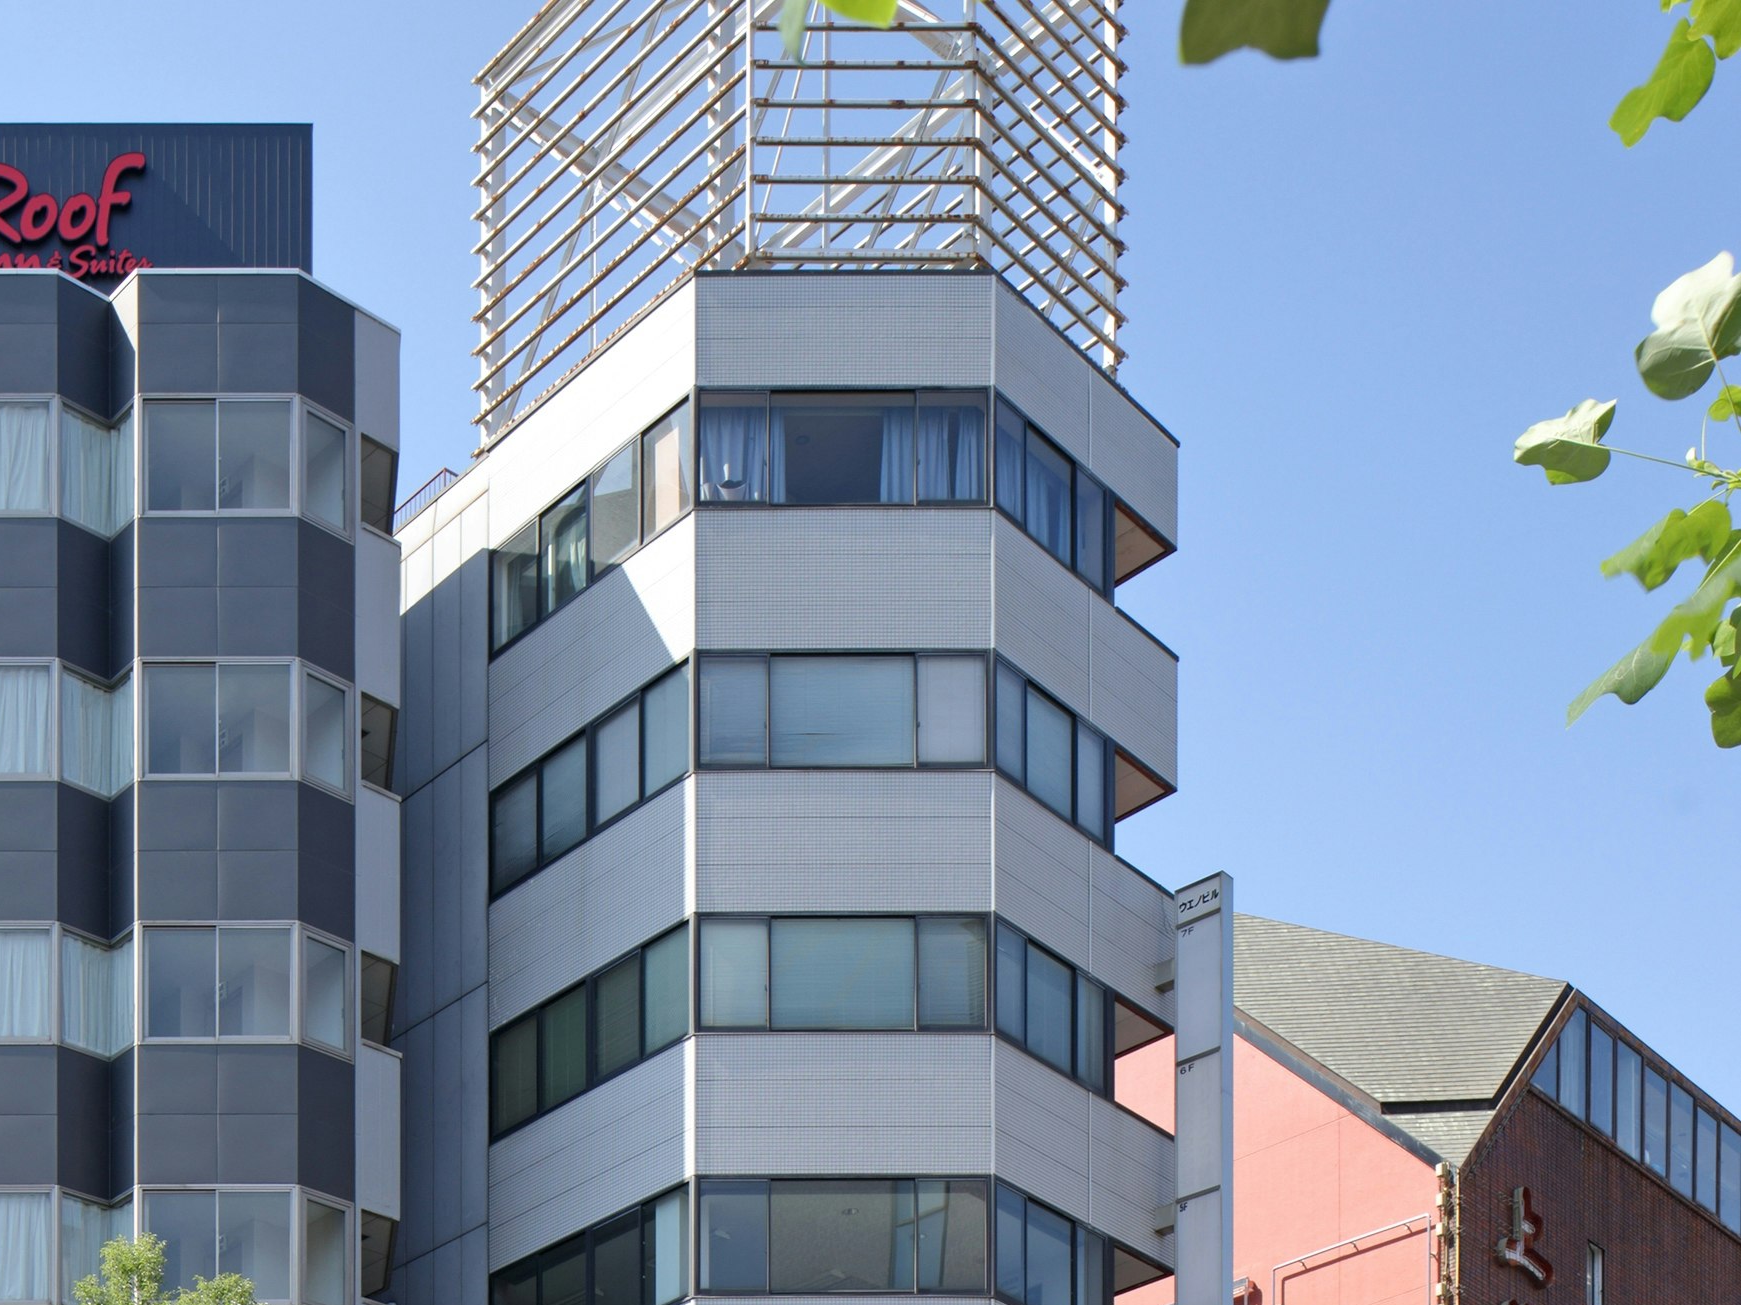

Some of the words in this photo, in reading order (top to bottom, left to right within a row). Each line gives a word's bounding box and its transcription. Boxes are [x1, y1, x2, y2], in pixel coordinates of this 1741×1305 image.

[1179, 888, 1219, 913] ウエノビル
[1181, 926, 1194, 938] 7F
[1180, 1063, 1194, 1075] 6F
[1180, 1202, 1188, 1212] 5F
